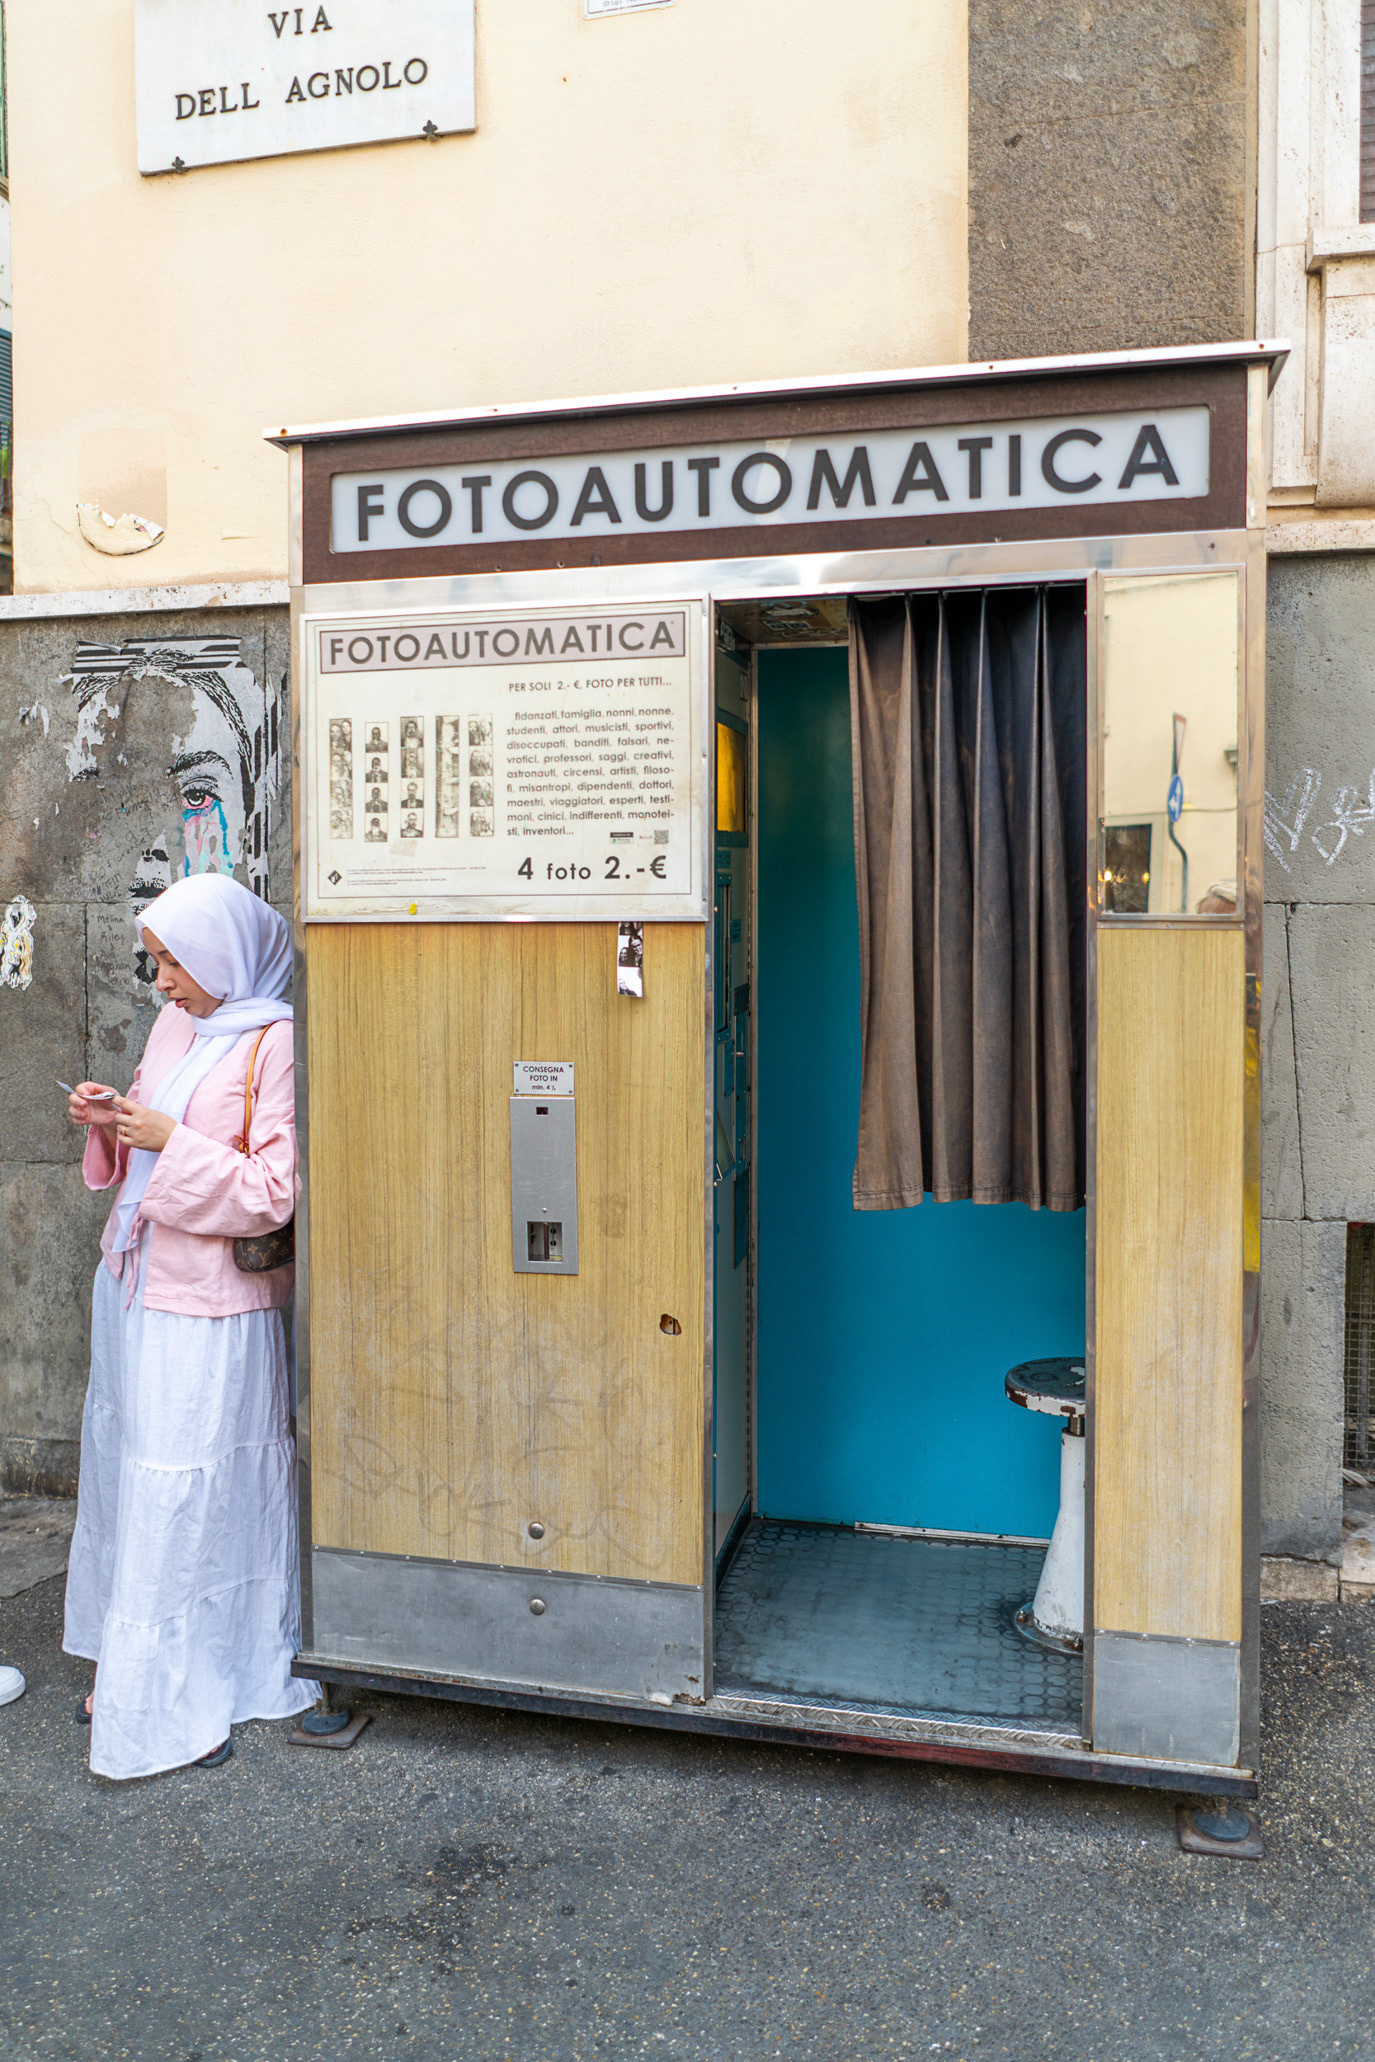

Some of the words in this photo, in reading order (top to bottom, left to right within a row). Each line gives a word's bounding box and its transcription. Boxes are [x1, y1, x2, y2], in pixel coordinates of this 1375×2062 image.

[268, 5, 332, 38] VIA
[175, 84, 260, 120] DELL
[285, 58, 428, 103] AGNOLO
[357, 424, 1179, 542] FOTOAUTOMATICA
[330, 621, 675, 665] FOTOAUTOMATICA
[509, 683, 526, 692] PER
[529, 682, 551, 691] SOLI
[586, 679, 614, 689] FOTO
[618, 678, 635, 687] PER
[638, 677, 672, 686] TUTTI...
[515, 711, 559, 720] fidanzati,
[561, 709, 604, 720] famiglia,
[606, 708, 636, 717] nonni,
[639, 707, 673, 716] nonne,
[507, 725, 547, 735] studenti,
[553, 724, 580, 734] attori,
[585, 723, 630, 732] musicisti,
[635, 721, 674, 732] sportivi,
[507, 739, 568, 750] disoccupati,
[574, 738, 611, 747] banditi,
[618, 737, 651, 746] falsari,
[507, 754, 539, 764] vrotici,
[544, 753, 594, 763] professori,
[599, 752, 629, 762] saggi,
[634, 751, 674, 760] creativi,
[507, 768, 558, 778] astronauti,
[564, 767, 605, 777] circensi,
[610, 766, 639, 775] artisti,
[643, 766, 674, 774] filoso-
[507, 784, 515, 792] fi,
[519, 782, 573, 792] misantropi,
[577, 781, 634, 791] dipendenti,
[639, 780, 674, 790] dottori,
[507, 797, 545, 807] maestri,
[550, 796, 605, 807] viaggiatori,
[610, 795, 646, 805] esperti,
[649, 794, 674, 804] testi-
[507, 812, 534, 822] moni,
[538, 811, 566, 821] cinici,
[569, 810, 624, 820] indifferenti,
[628, 809, 674, 819] monotei-
[507, 827, 520, 836] sti,
[523, 826, 574, 835] inventori...
[518, 857, 533, 880] 4
[547, 863, 591, 880] foto
